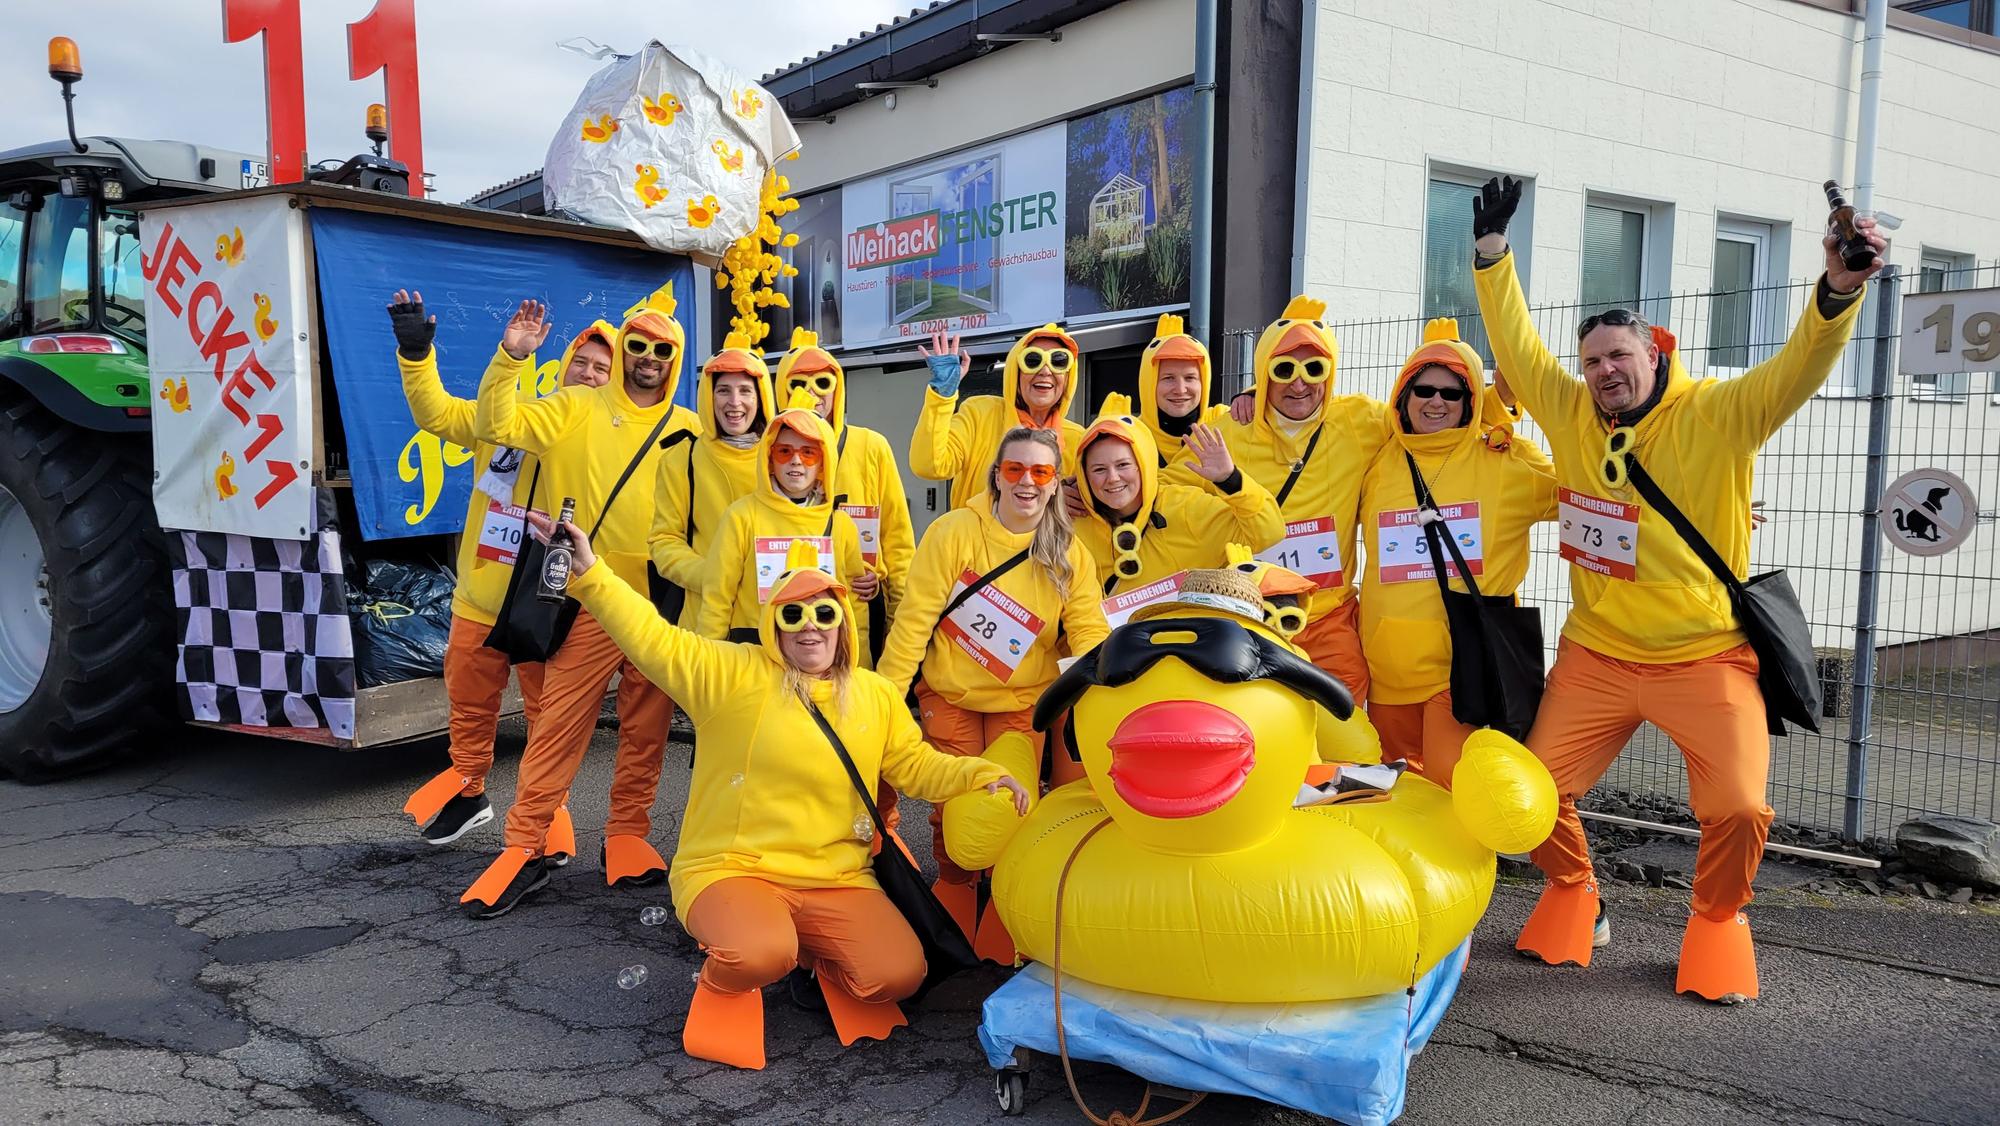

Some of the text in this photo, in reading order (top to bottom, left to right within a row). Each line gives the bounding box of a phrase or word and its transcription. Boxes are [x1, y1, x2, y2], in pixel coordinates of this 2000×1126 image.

[848, 190, 1058, 266] Meihack FENSTER
[847, 280, 877, 292] Haustüren
[988, 248, 1058, 268] Gewächshausbau
[920, 319, 949, 334] 02204
[960, 313, 987, 330] 71071
[1922, 303, 2000, 362] 19
[1569, 492, 1625, 517] ENTENRENNEN
[1581, 523, 1603, 547] 73
[1278, 549, 1300, 568] 11
[1116, 578, 1177, 609] ENTENRENNEN
[970, 613, 997, 639] 28
